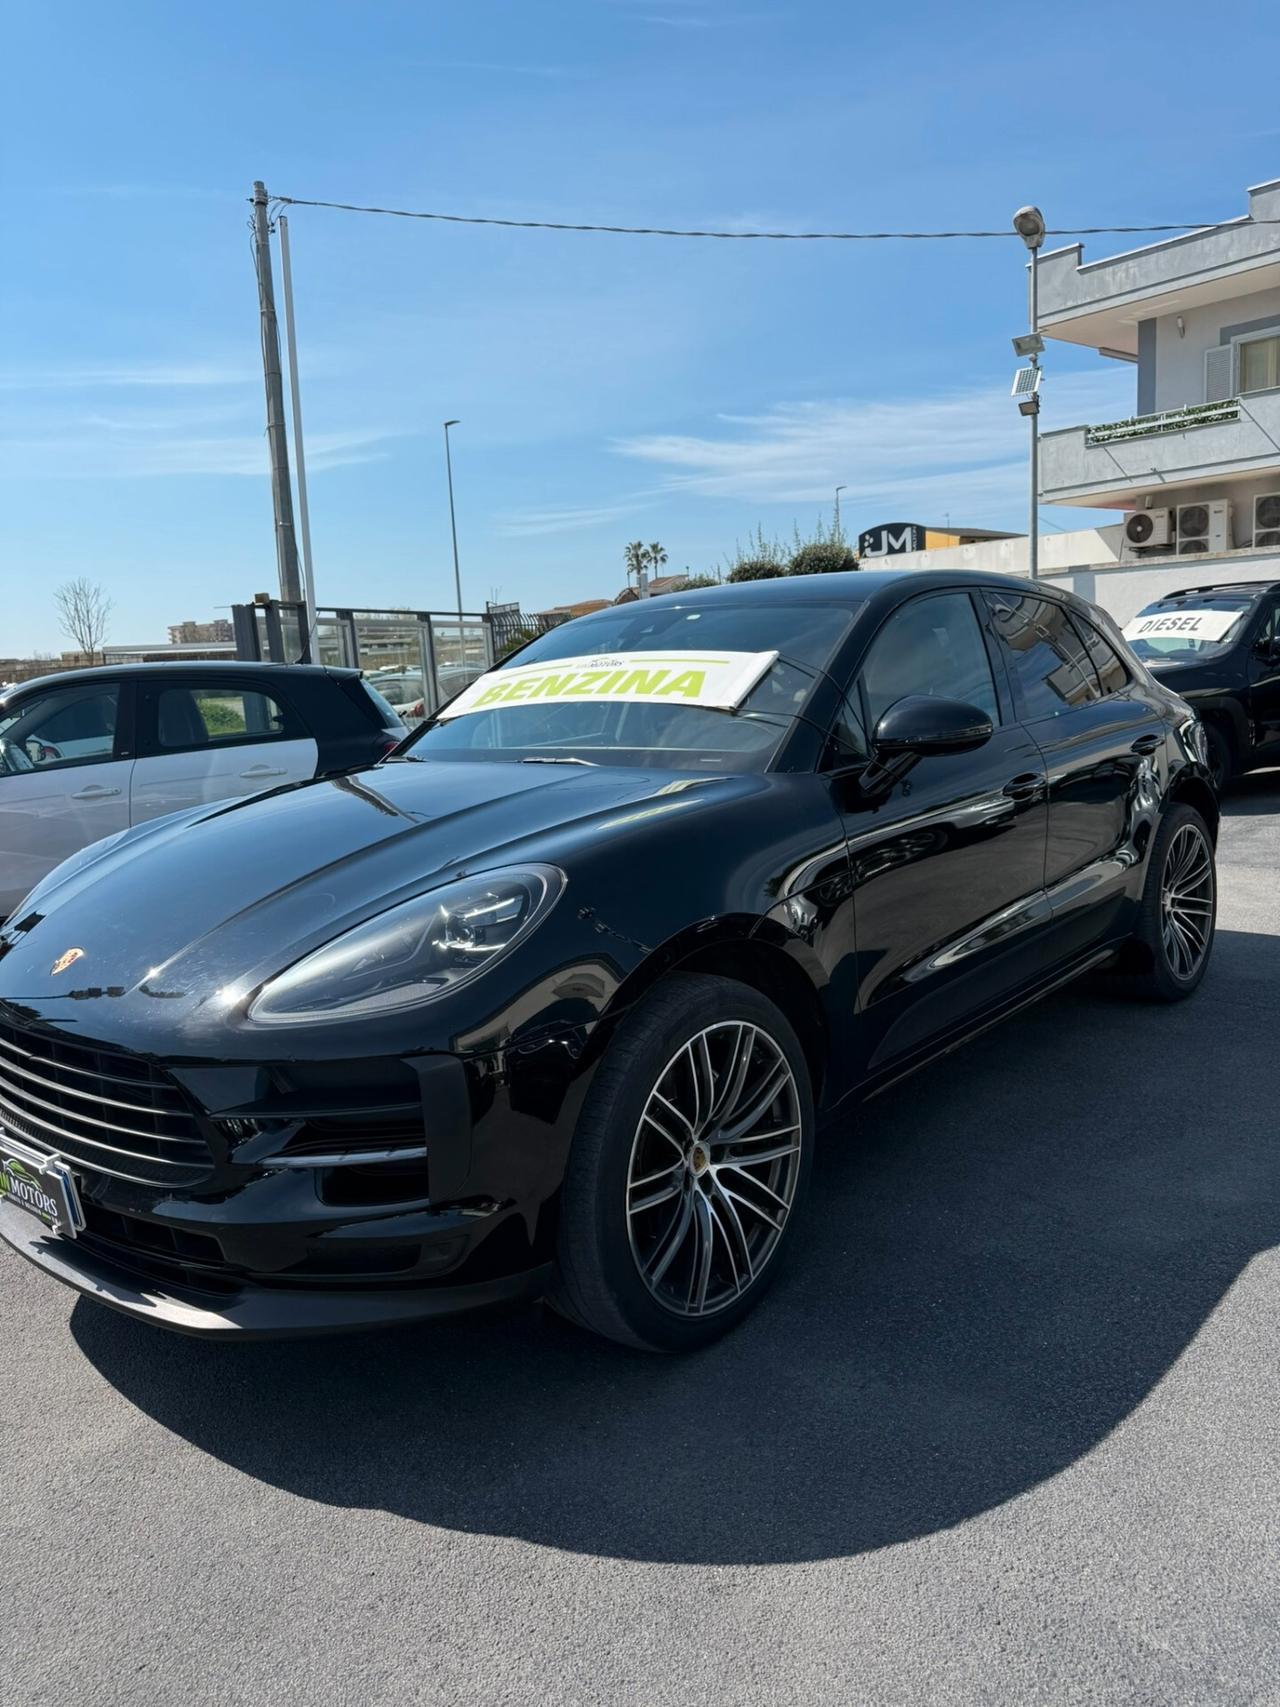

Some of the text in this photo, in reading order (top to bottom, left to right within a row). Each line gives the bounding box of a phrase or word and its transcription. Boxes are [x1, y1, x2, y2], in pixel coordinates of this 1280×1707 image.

[1137, 616, 1203, 634] DIESEL
[470, 670, 707, 708] BENZINA
[9, 1176, 58, 1217] MOTORS
